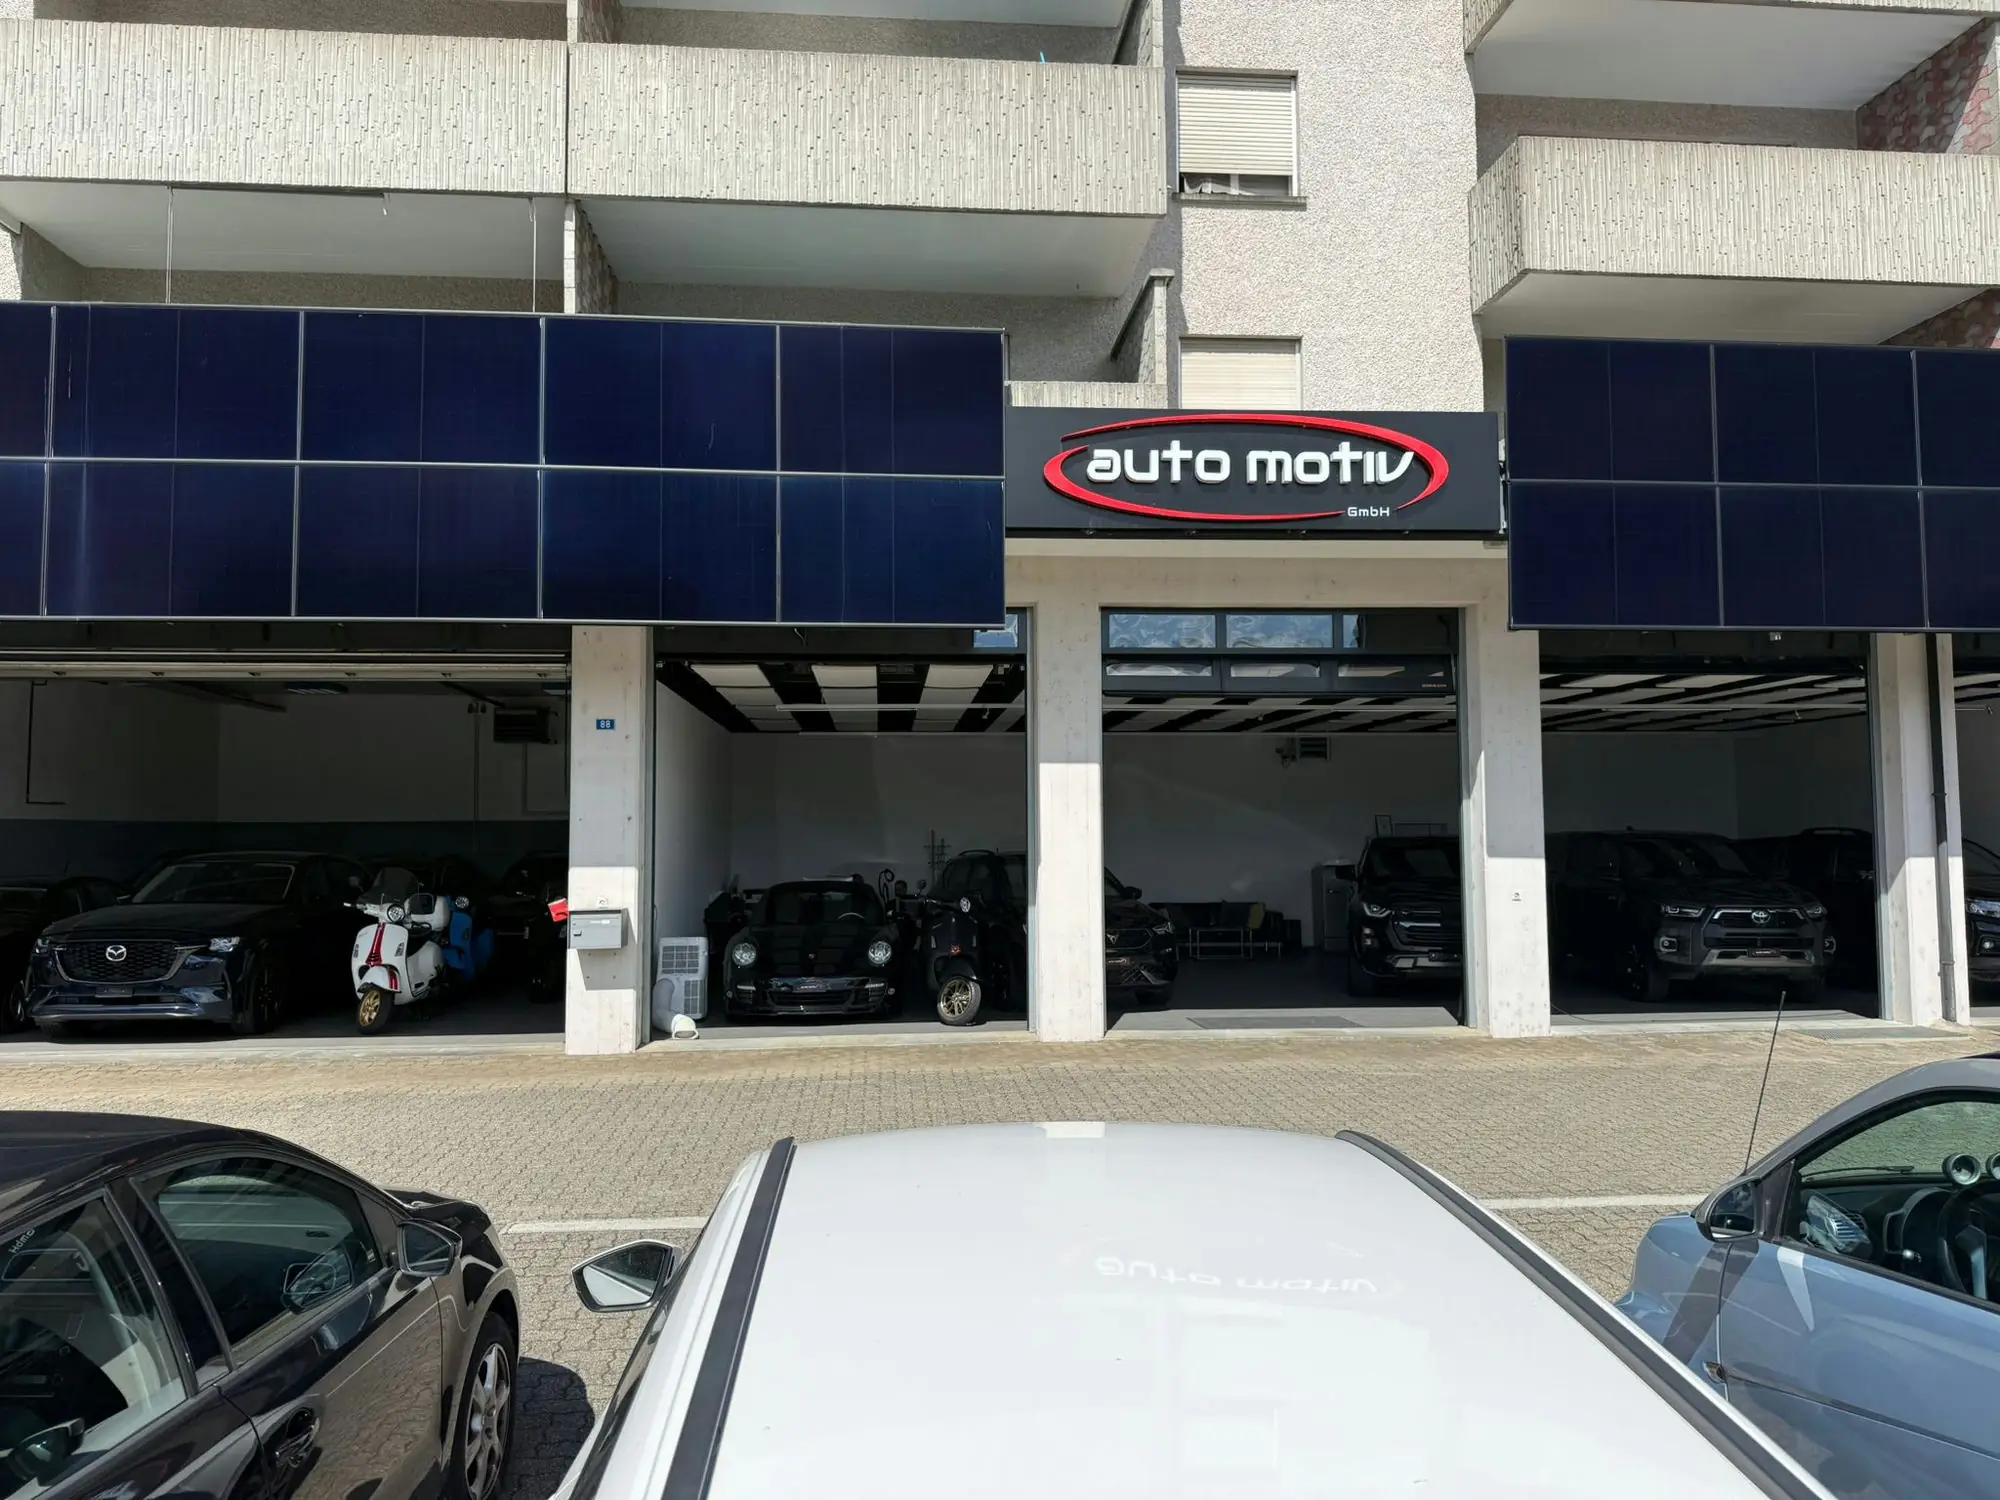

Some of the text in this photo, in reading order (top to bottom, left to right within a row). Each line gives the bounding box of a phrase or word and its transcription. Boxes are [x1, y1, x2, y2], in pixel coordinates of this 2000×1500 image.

[1086, 439, 1414, 485] auto motiv
[1346, 506, 1390, 518] GmbH
[600, 719, 611, 729] 88
